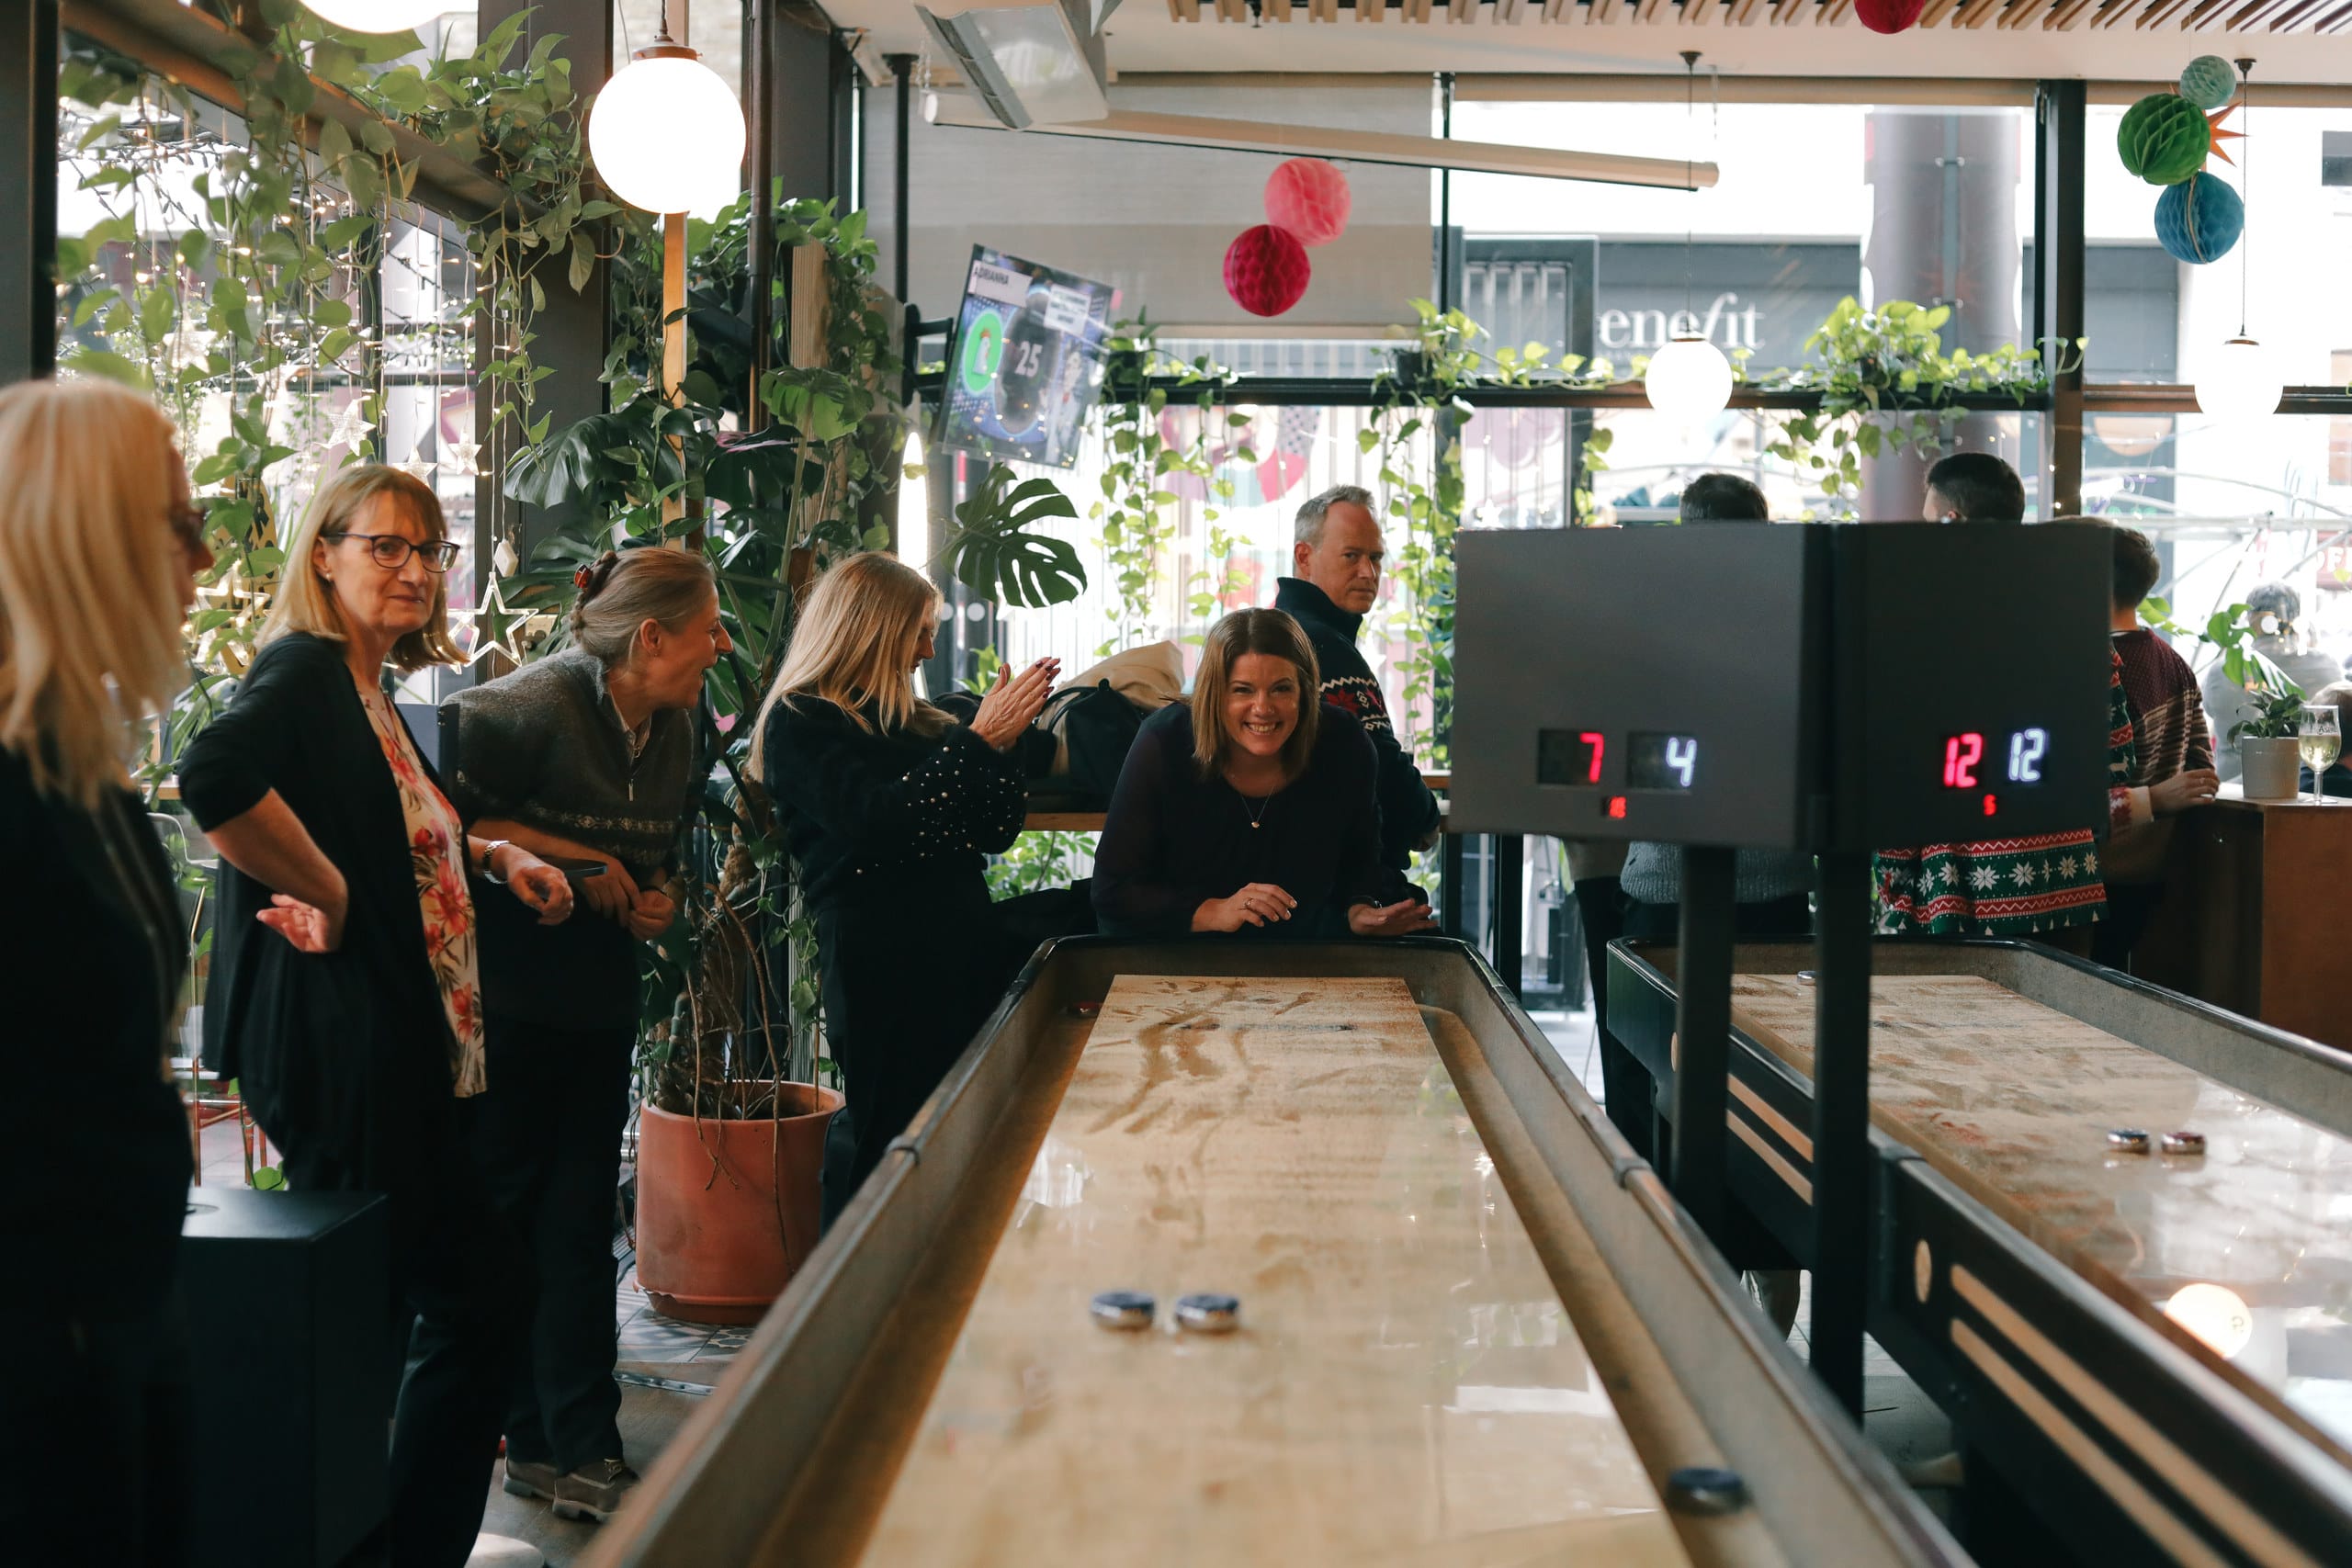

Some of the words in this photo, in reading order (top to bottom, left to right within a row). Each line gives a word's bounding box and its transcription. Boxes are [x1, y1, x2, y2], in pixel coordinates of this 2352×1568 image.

[1597, 292, 1766, 349] enefit
[1015, 341, 1043, 378] 25
[1579, 732, 1604, 784] 7
[1666, 737, 1697, 787] 4
[1943, 732, 1983, 788] 12
[2008, 728, 2046, 782] 12
